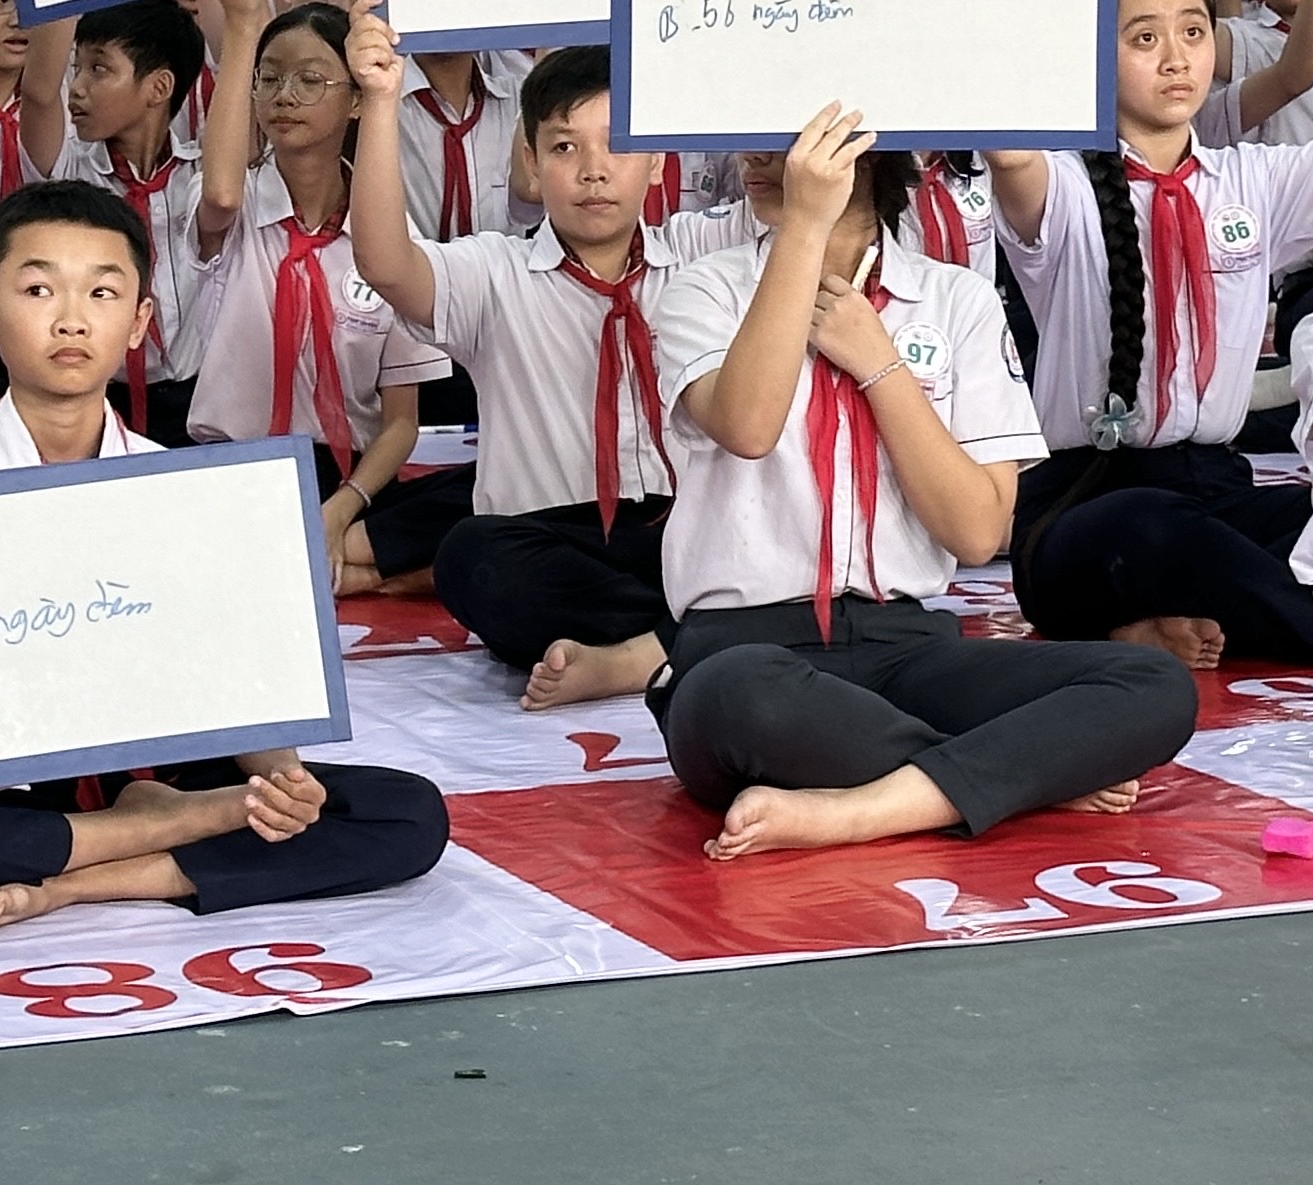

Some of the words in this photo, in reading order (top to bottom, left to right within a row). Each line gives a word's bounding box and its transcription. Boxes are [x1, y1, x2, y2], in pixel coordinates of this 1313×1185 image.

[962, 191, 987, 213] 76
[1221, 220, 1251, 243] 86
[907, 342, 938, 366] 97
[894, 860, 1223, 934] 97
